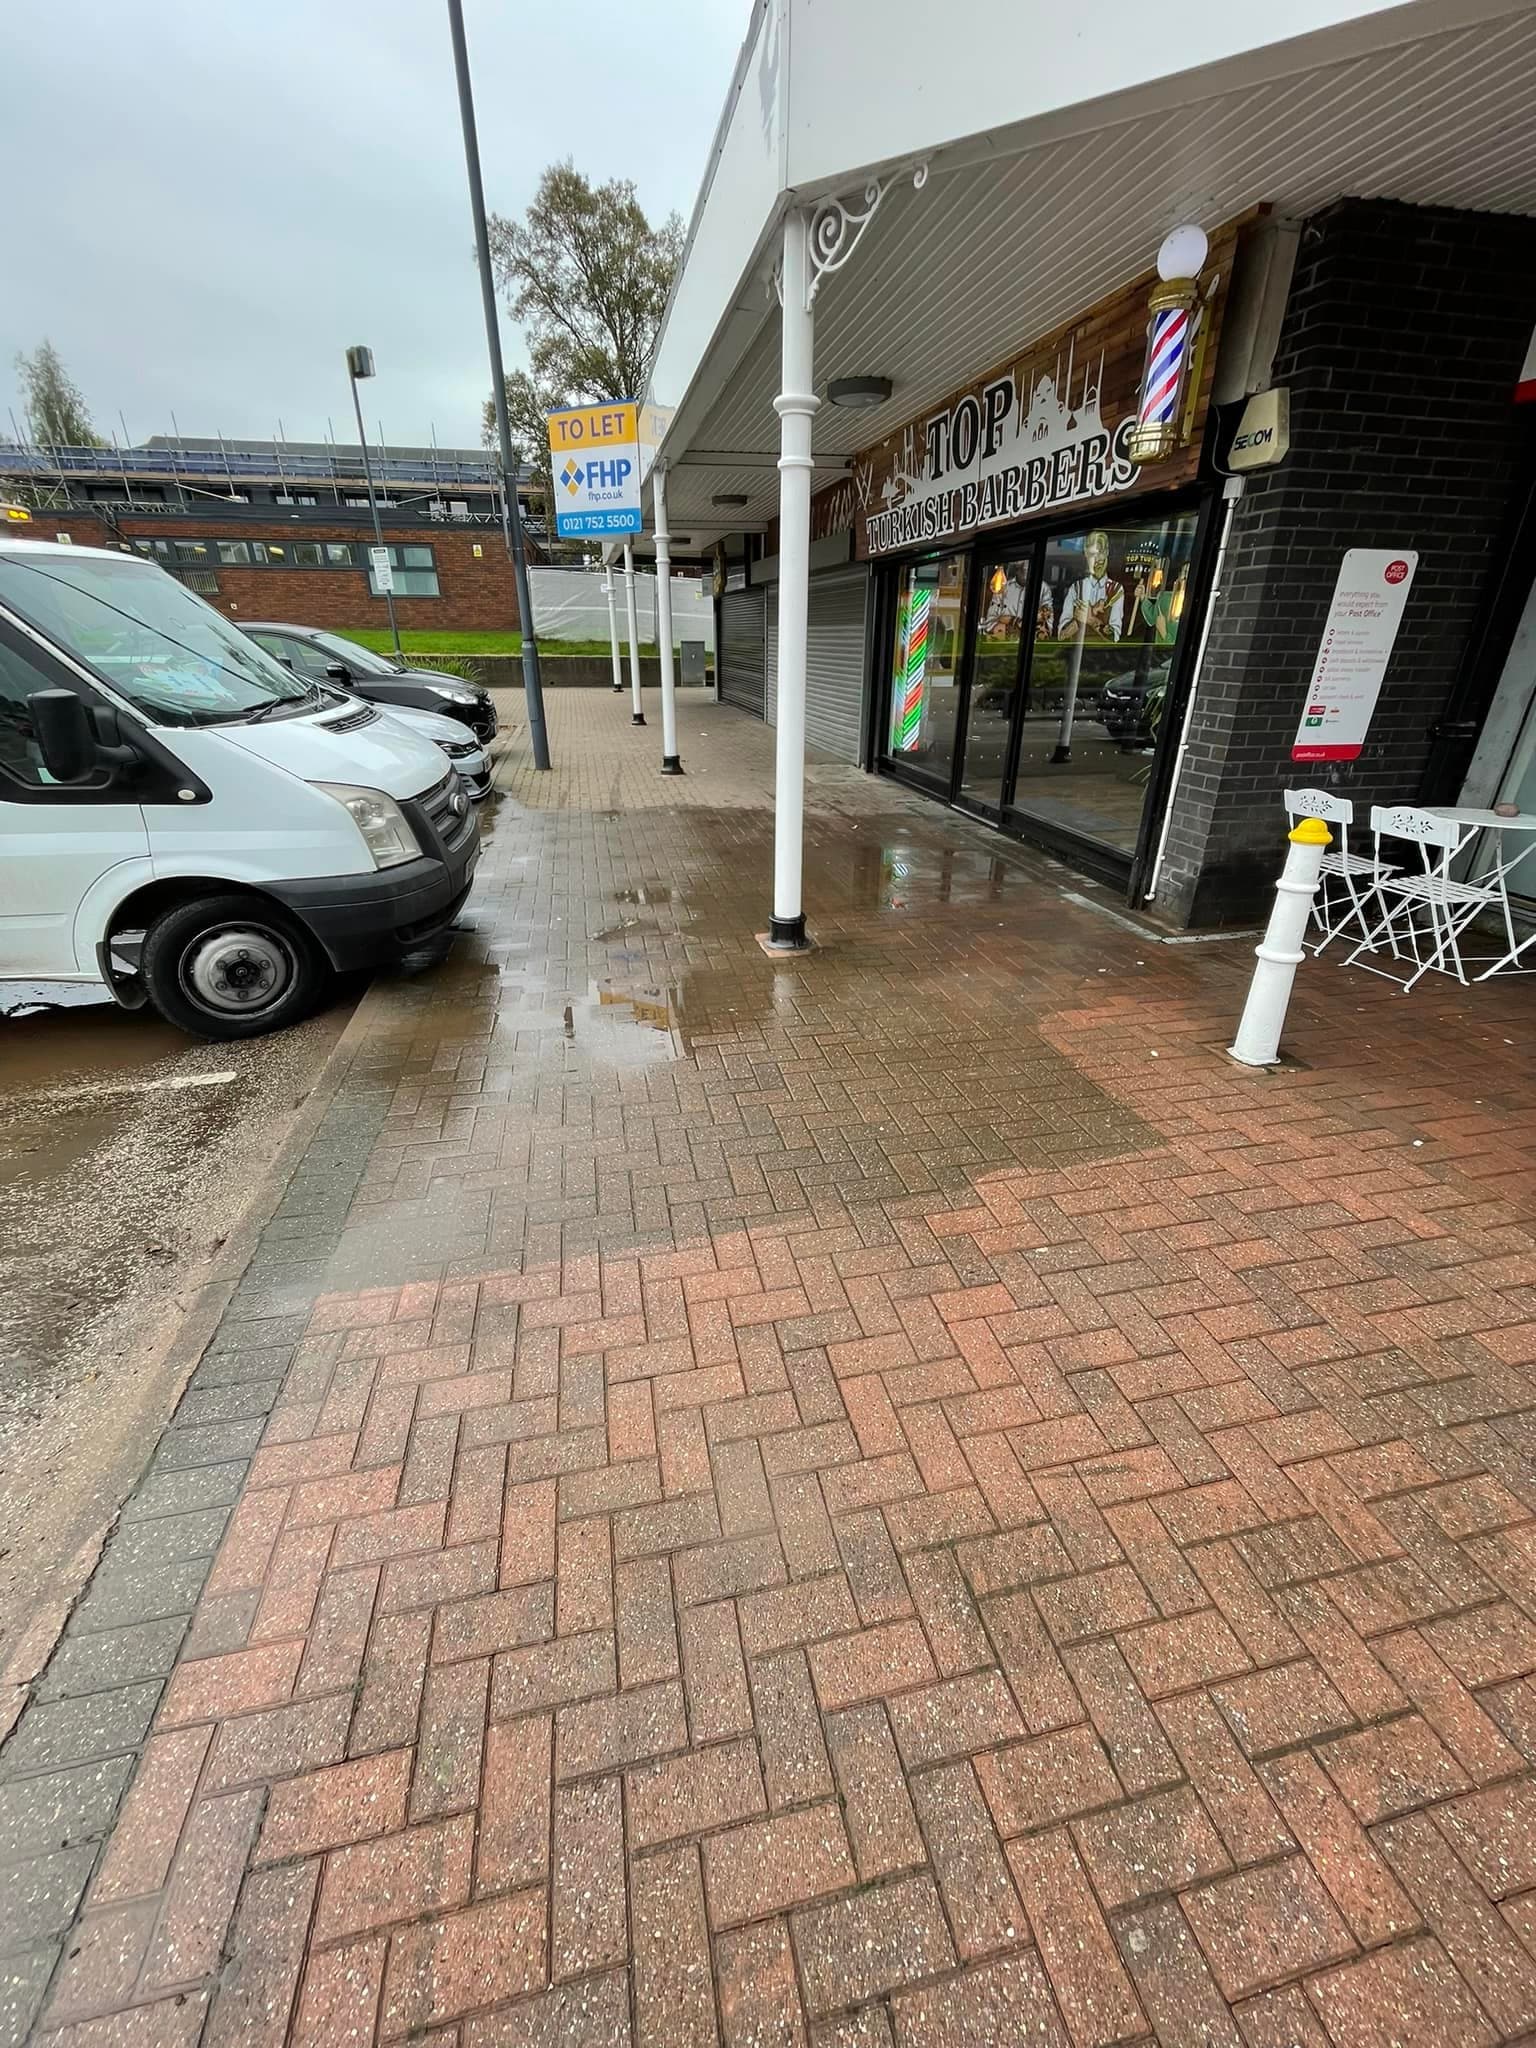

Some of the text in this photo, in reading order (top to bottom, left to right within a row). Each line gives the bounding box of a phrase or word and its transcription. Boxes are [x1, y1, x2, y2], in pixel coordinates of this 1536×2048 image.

[558, 418, 584, 441] TO
[590, 413, 625, 438] LET
[927, 379, 1014, 481] TOP
[1234, 427, 1273, 451] SECOM
[586, 458, 632, 489] FHP
[866, 417, 1142, 555] TURKISH BARBERS
[588, 490, 624, 503] fhp.co.uk
[563, 514, 635, 531] 0121 752 5500
